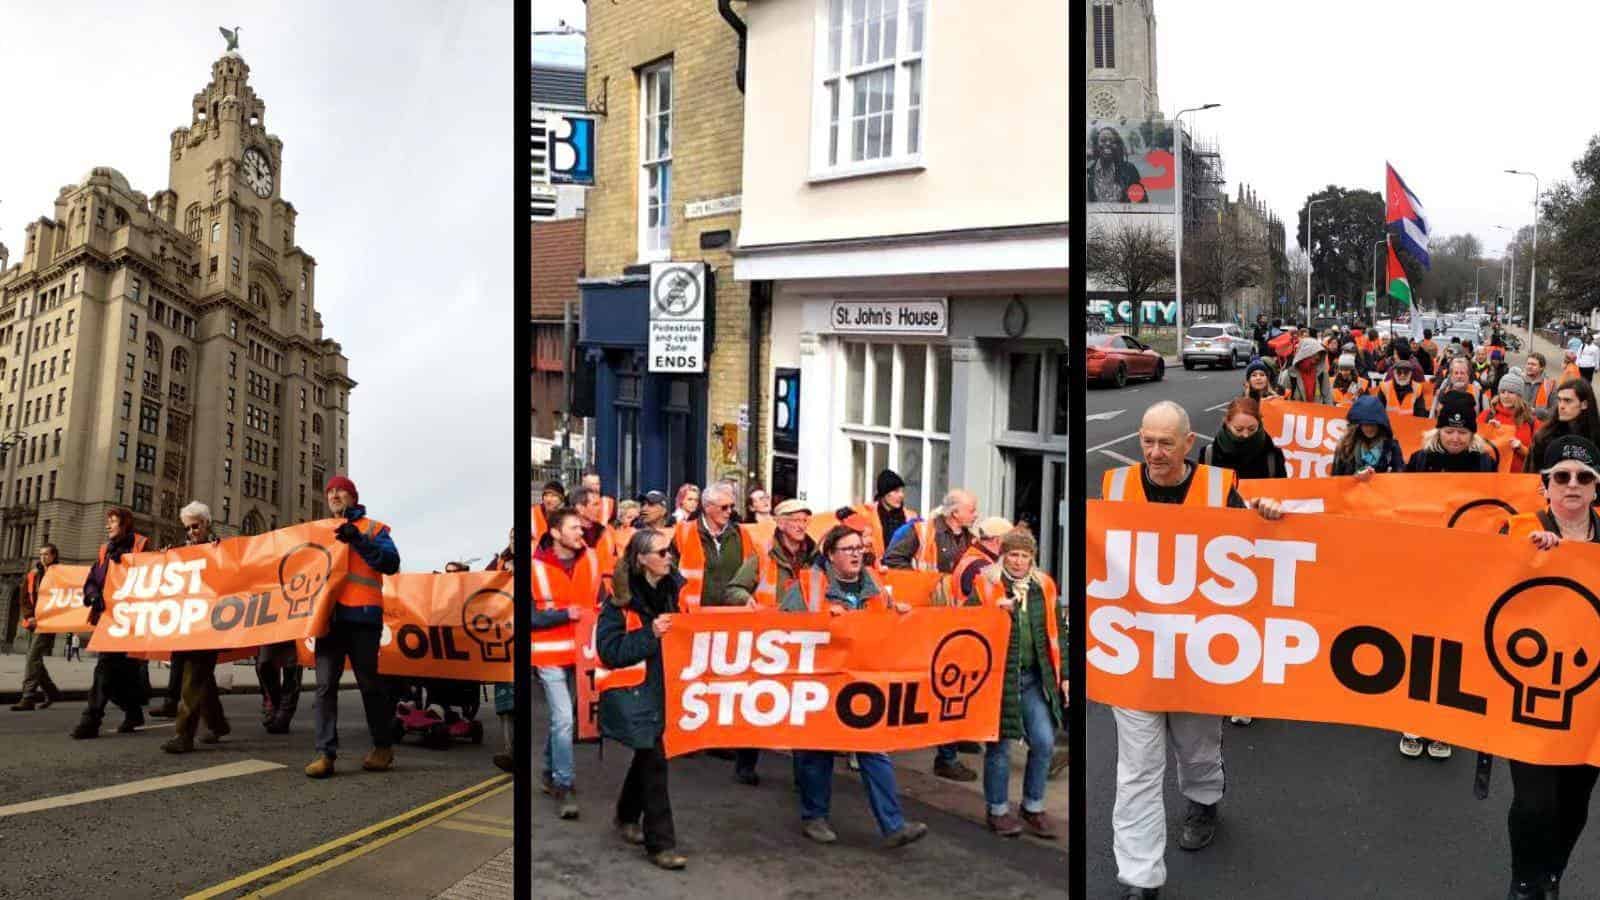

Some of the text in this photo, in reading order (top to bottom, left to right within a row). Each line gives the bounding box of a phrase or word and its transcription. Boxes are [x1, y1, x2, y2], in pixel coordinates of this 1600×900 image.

[836, 307, 939, 325] St. John's House
[655, 355, 697, 368] ENDS
[1273, 413, 1348, 450] JUS
[112, 558, 207, 600] JUST
[1087, 530, 1317, 608] JUST
[44, 588, 84, 610] JUS
[108, 592, 278, 637] STOP OIL
[397, 624, 470, 661] OIL
[679, 629, 830, 681] JUST
[1087, 605, 1488, 716] STOP OIL
[678, 679, 929, 731] STOP OIL
